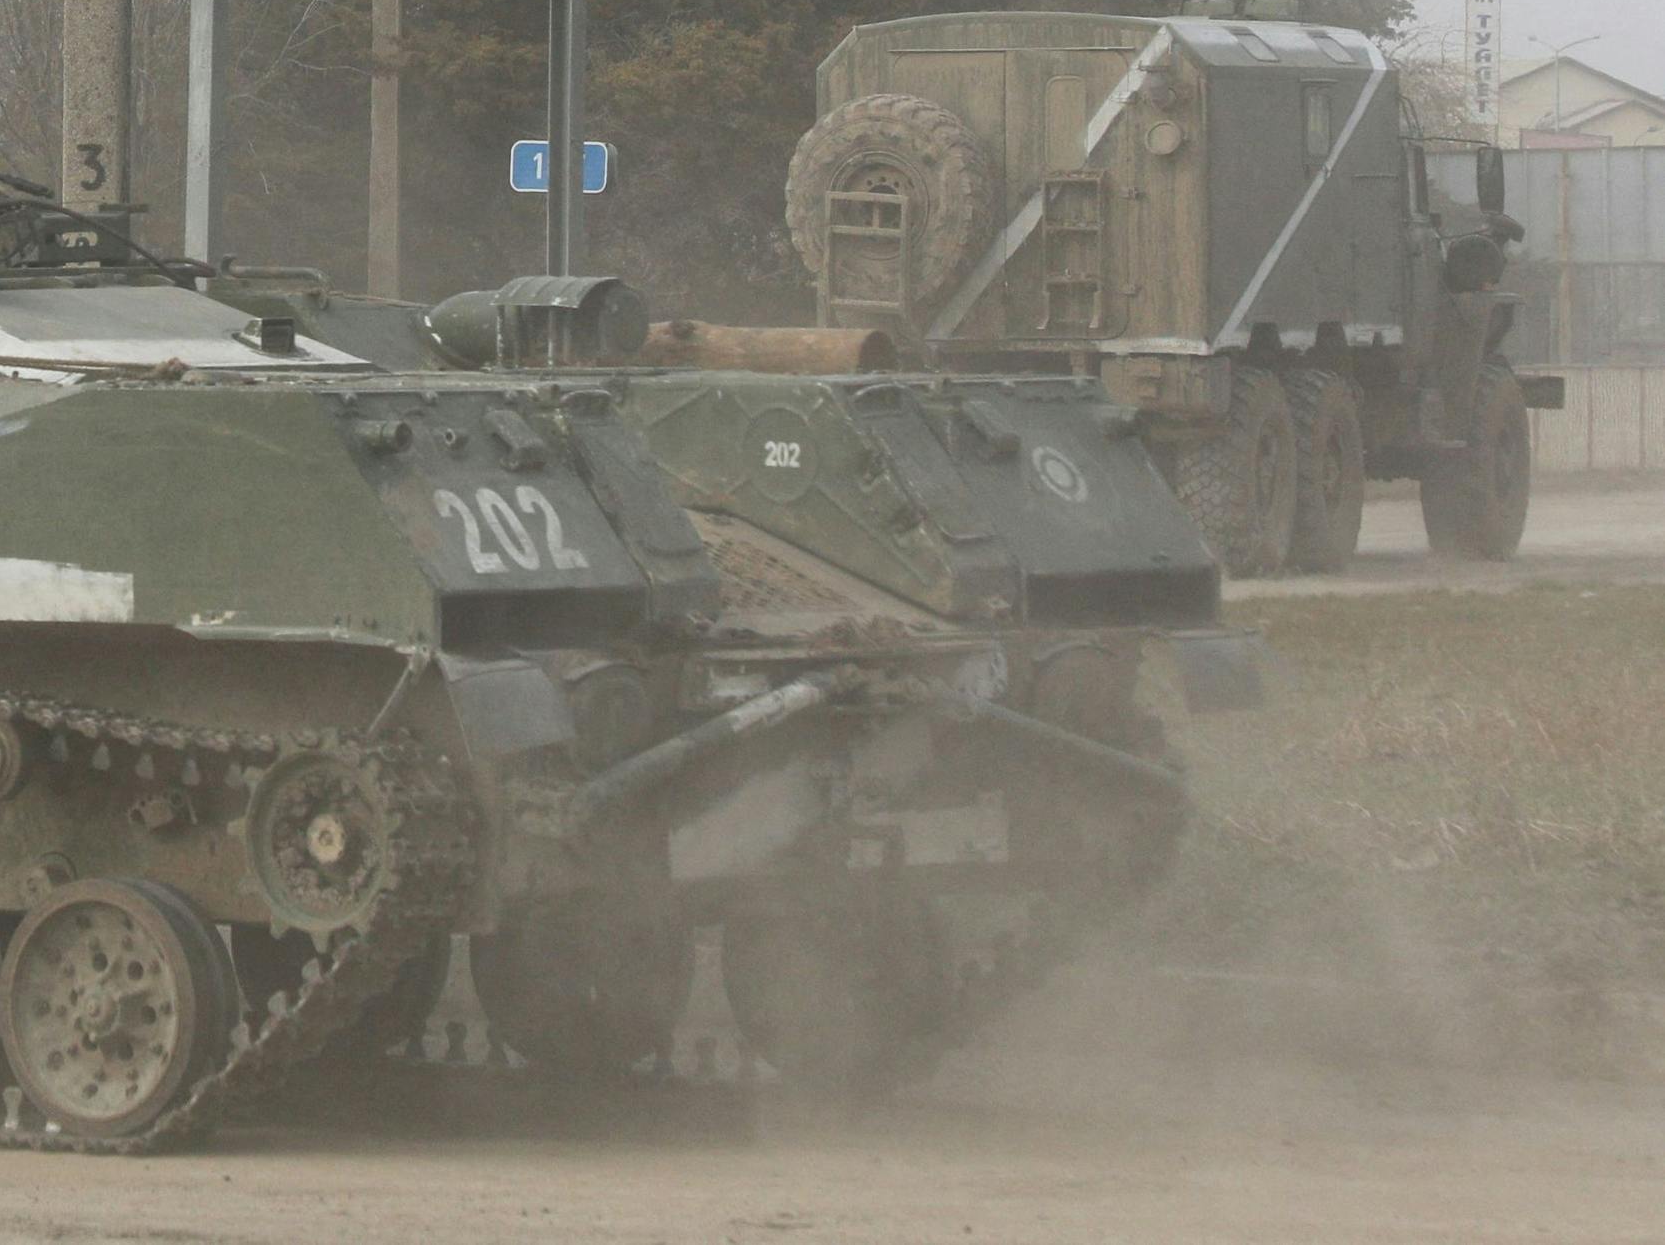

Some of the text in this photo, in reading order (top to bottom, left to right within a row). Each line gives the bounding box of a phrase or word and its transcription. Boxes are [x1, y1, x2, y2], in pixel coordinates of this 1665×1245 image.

[76, 143, 106, 191] 3
[764, 440, 802, 469] 202
[433, 485, 590, 574] 202
